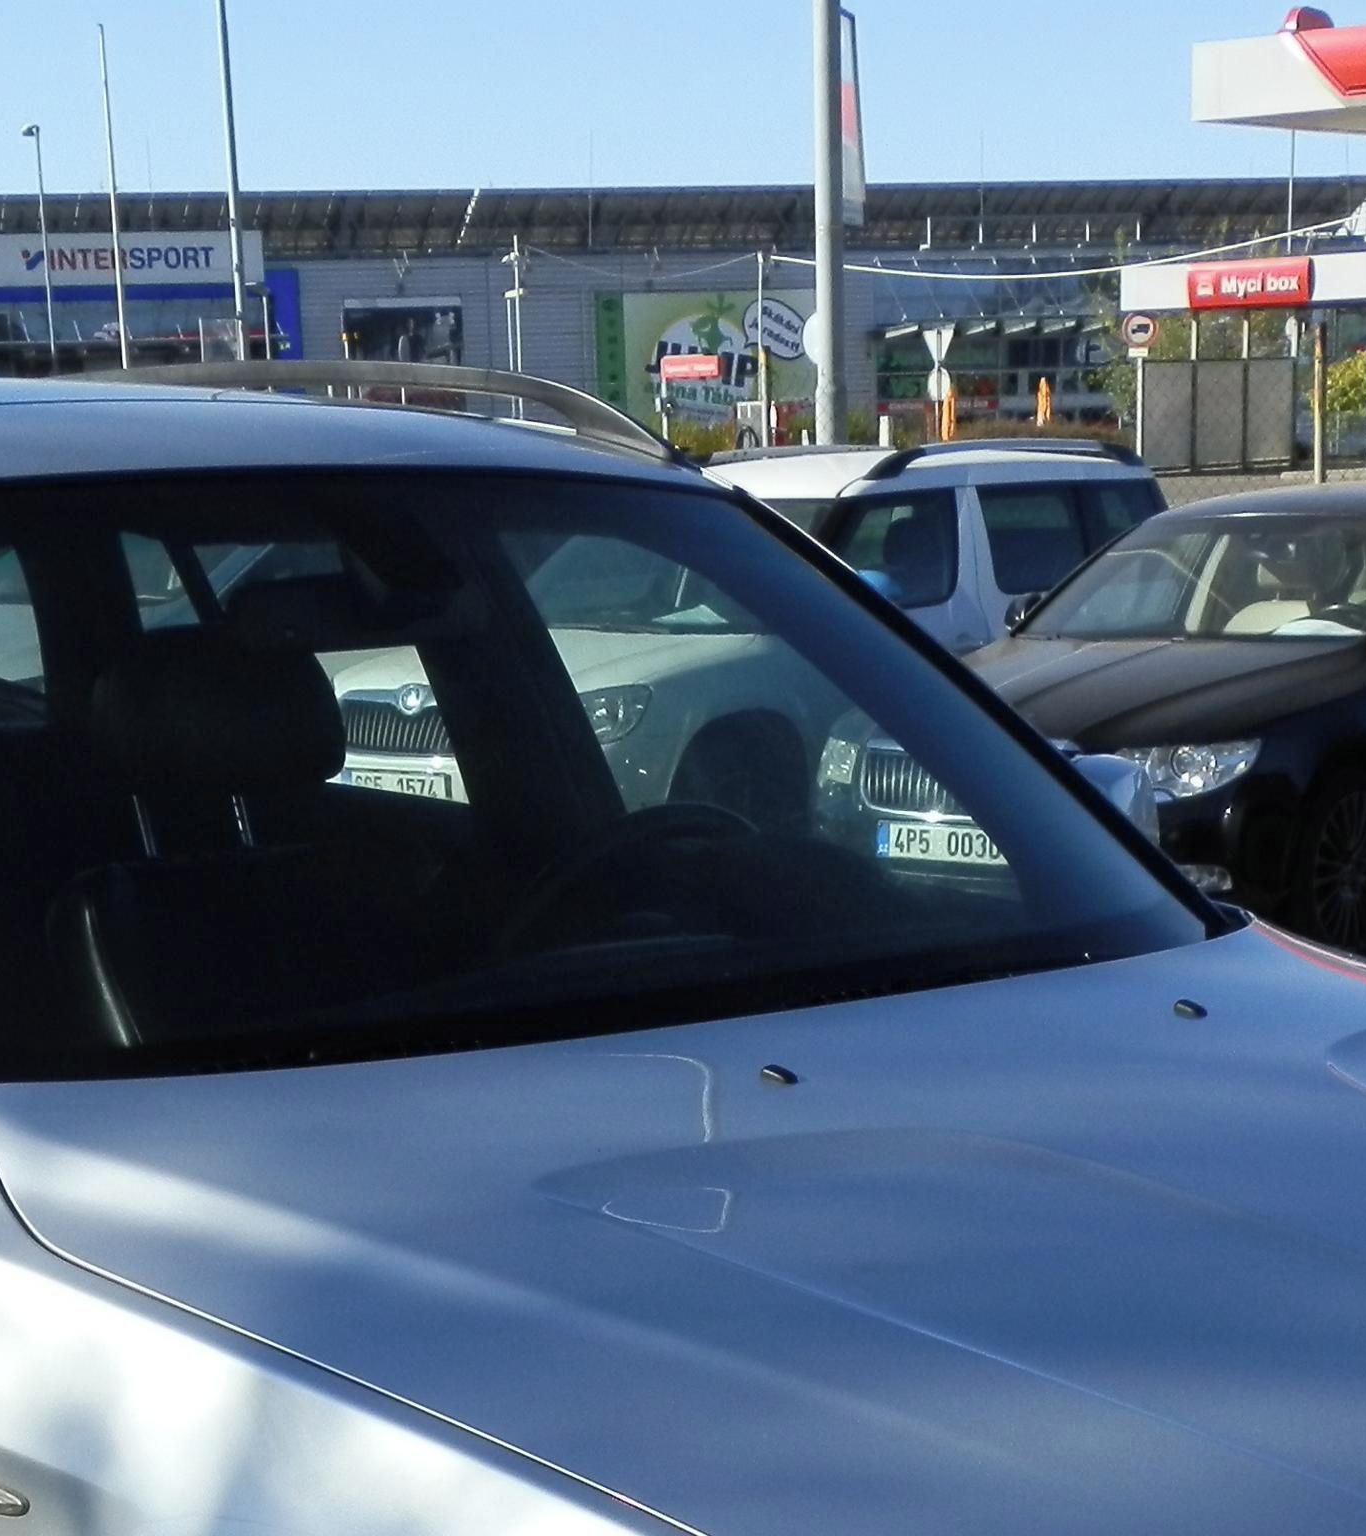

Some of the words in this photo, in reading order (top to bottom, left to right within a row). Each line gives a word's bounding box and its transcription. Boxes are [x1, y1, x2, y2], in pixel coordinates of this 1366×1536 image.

[49, 246, 214, 271] INTERSPORT
[1220, 272, 1263, 298] Mycí
[1266, 272, 1300, 292] box
[894, 827, 931, 855] 4P5
